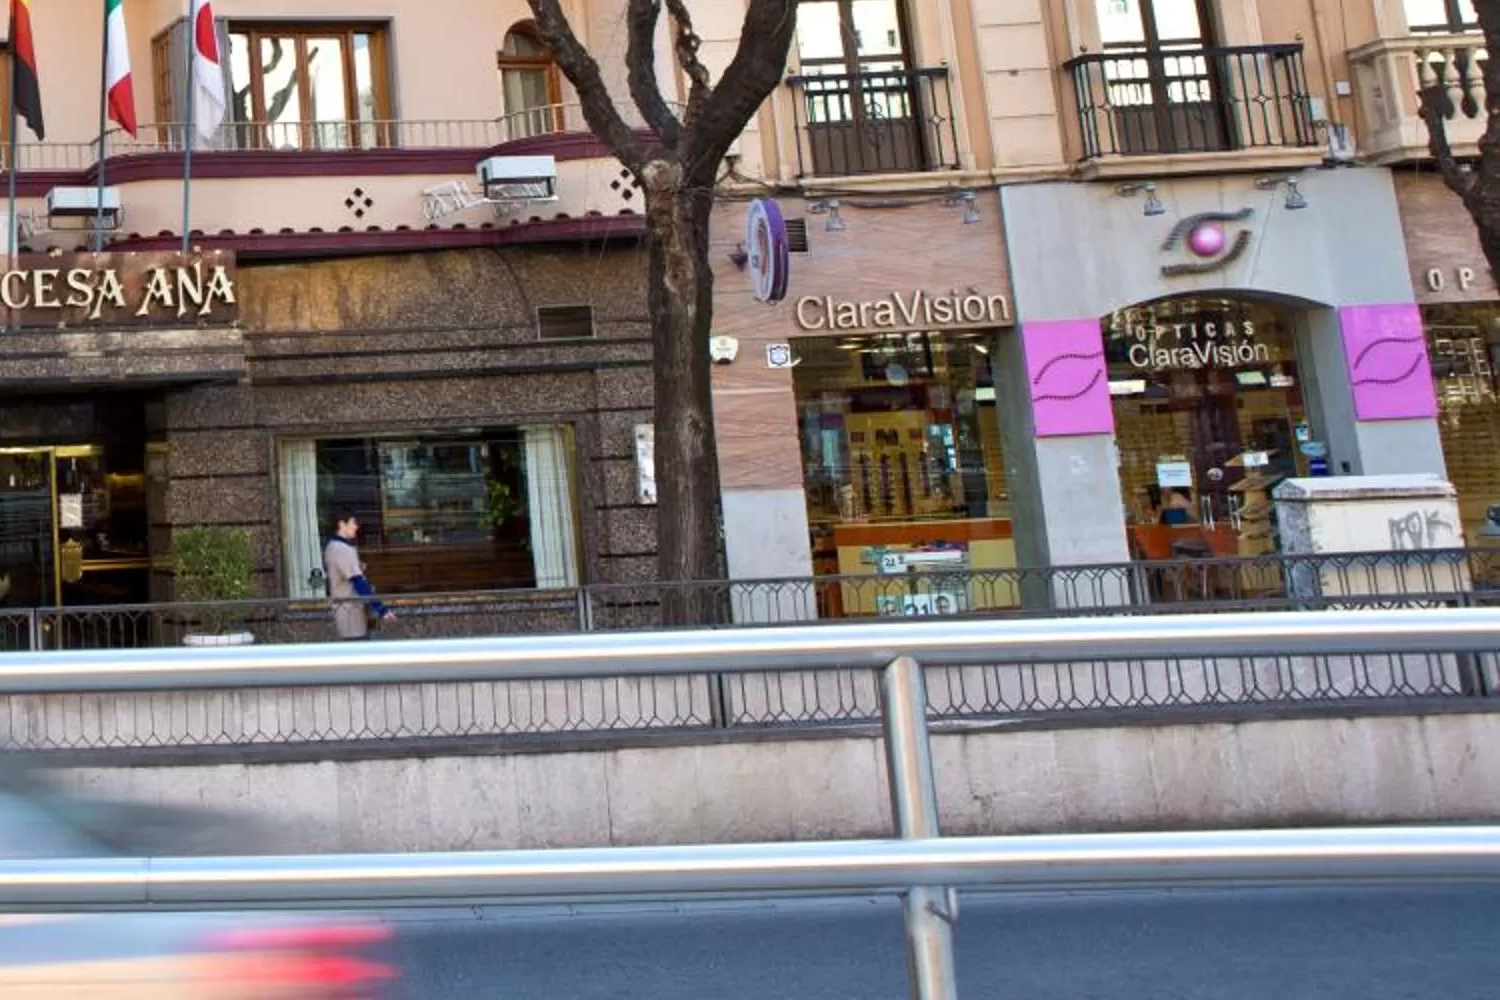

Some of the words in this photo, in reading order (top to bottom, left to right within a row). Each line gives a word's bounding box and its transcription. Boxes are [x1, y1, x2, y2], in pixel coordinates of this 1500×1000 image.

[135, 262, 235, 317] ANA
[796, 288, 1010, 330] ClaraVisión
[1135, 320, 1255, 341] OPTICAS
[1128, 338, 1269, 367] ClaraVisión
